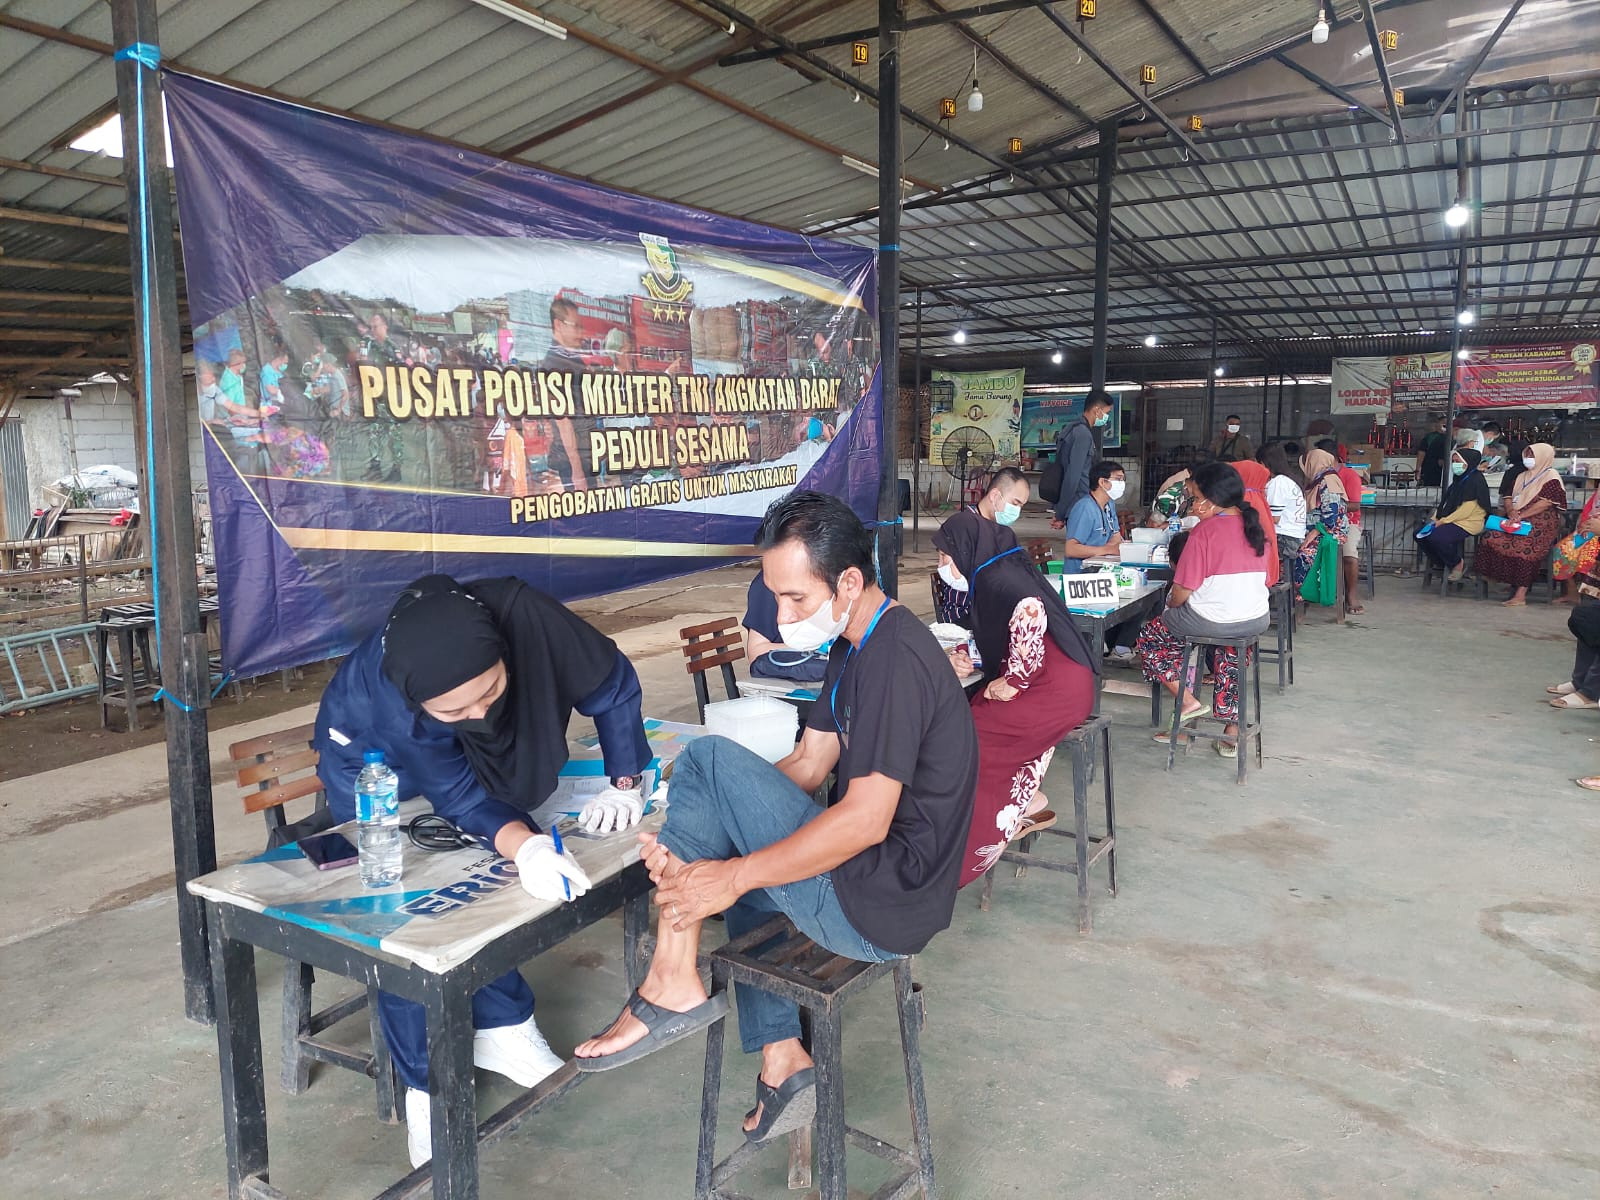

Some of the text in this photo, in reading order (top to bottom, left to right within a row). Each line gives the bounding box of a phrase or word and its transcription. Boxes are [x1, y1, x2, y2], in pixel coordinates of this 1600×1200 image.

[1081, 0, 1095, 16] 20
[855, 44, 867, 62] 19
[358, 365, 841, 418] PUSAT POLISI MILITER TNI ANGKATAN DARAT
[961, 376, 1016, 391] JAMBU
[1338, 389, 1371, 398] LOKET
[590, 424, 751, 473] PEDULI SESAMA
[510, 465, 798, 524] PENGOBATAN GRATIS UNTUK MASYARAKAT
[1068, 578, 1114, 599] DOKTER
